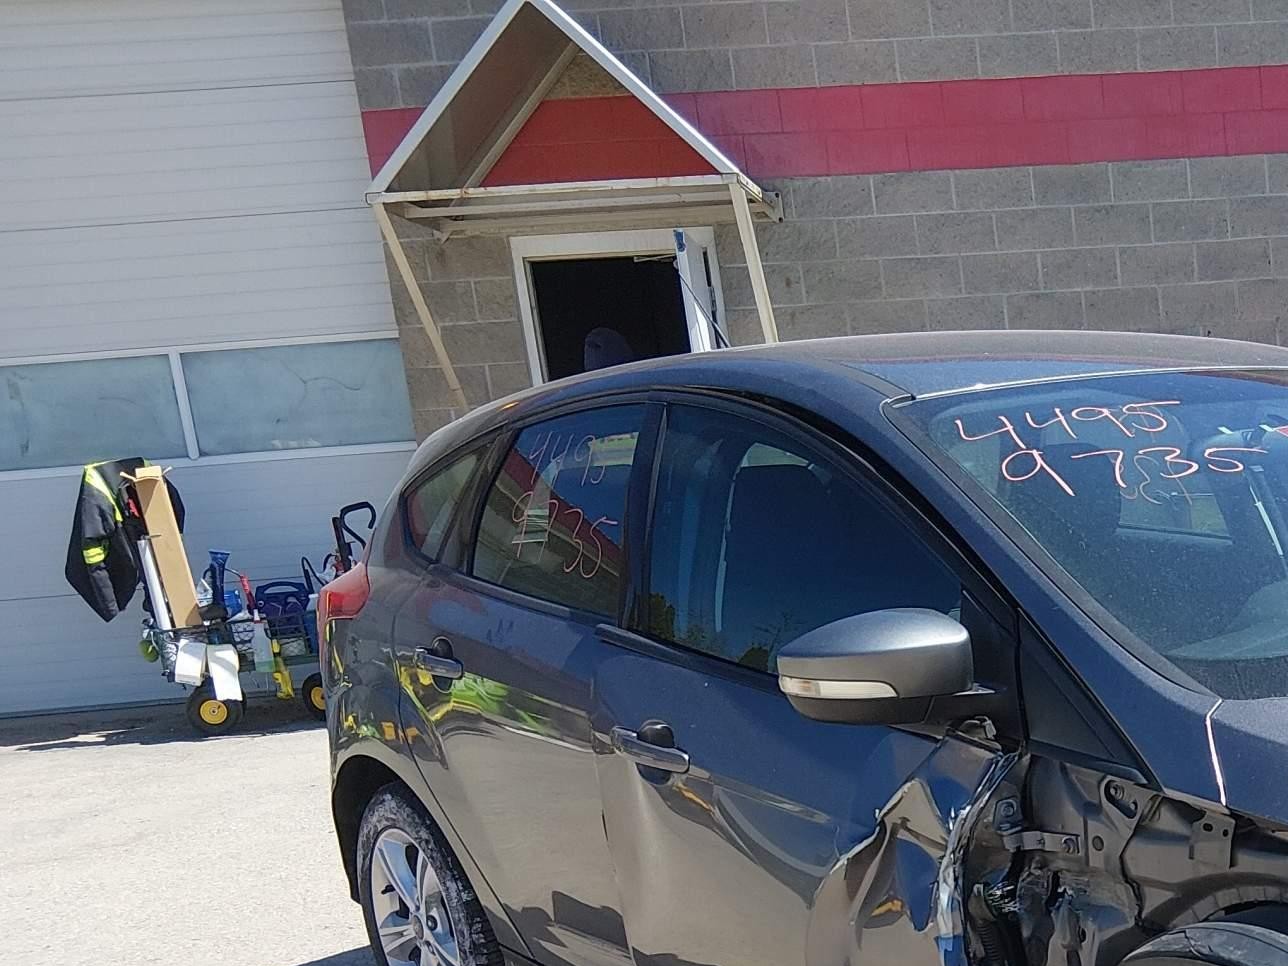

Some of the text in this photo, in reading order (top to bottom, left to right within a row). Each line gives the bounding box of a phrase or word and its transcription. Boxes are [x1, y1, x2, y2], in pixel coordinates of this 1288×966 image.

[955, 401, 1181, 448] 4495
[1001, 447, 1268, 497] 9735
[511, 490, 619, 578] 9735
